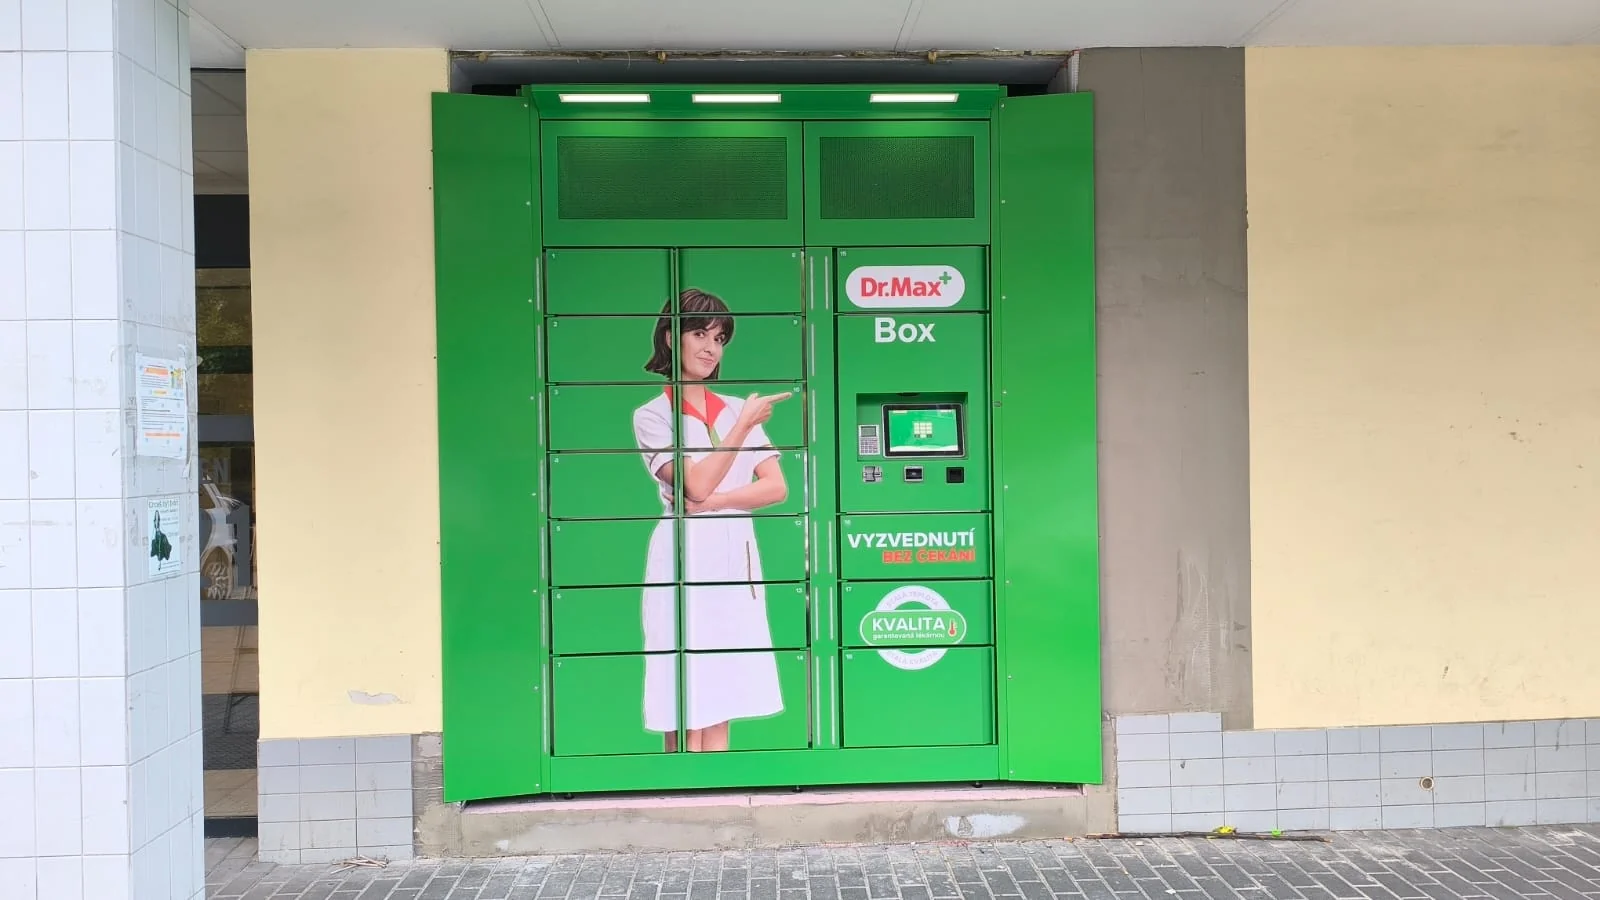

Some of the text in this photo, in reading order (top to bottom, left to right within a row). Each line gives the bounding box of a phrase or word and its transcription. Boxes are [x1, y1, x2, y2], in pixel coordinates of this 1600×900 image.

[861, 277, 942, 297] Dr.Max
[875, 317, 936, 343] Box
[848, 528, 975, 548] VYZVEDNUTÍ
[882, 547, 975, 563] BEZ ČEKÁNÍ
[872, 617, 946, 631] KVALITA
